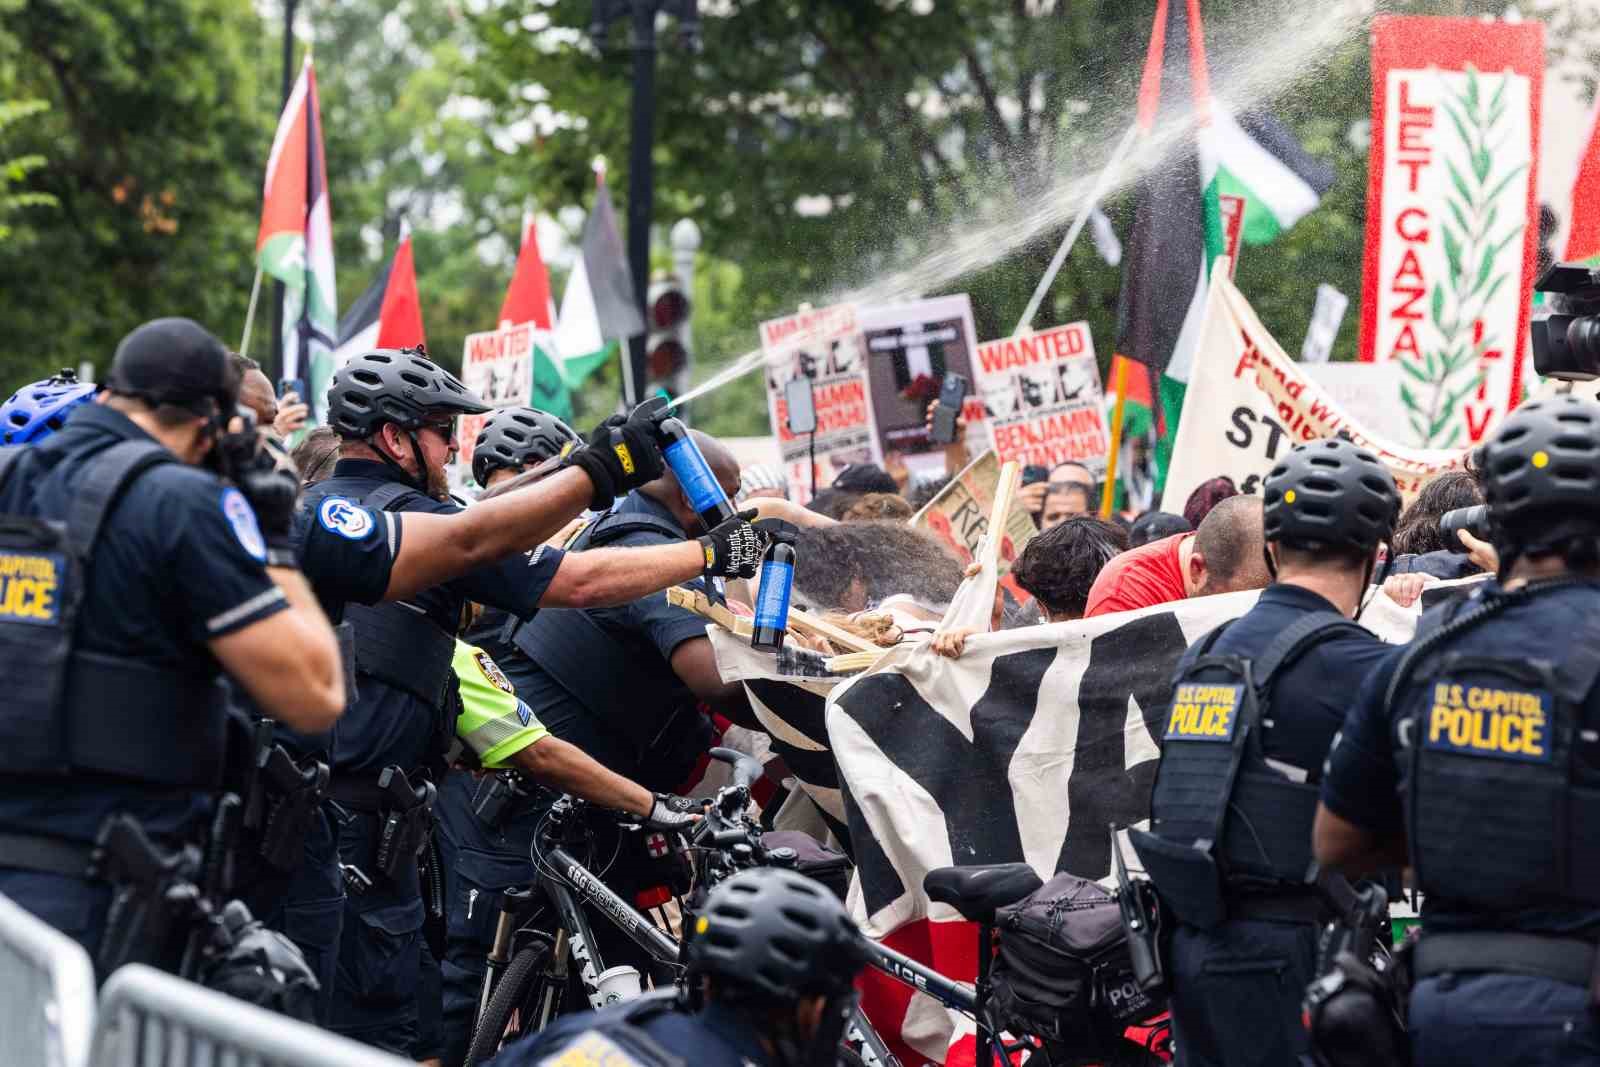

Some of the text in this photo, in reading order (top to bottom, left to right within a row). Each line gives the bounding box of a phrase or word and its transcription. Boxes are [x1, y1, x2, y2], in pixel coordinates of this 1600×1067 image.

[1388, 80, 1433, 360] LET GAZA
[978, 327, 1085, 373] WANTED
[993, 407, 1102, 452] BENJAMIN
[1225, 405, 1296, 460] ST
[0, 577, 58, 620] LICE
[1195, 687, 1237, 705] CAPITOL
[1467, 687, 1543, 718] CAPITOL
[1167, 702, 1234, 736] POLICE
[1429, 704, 1546, 756] POLICE
